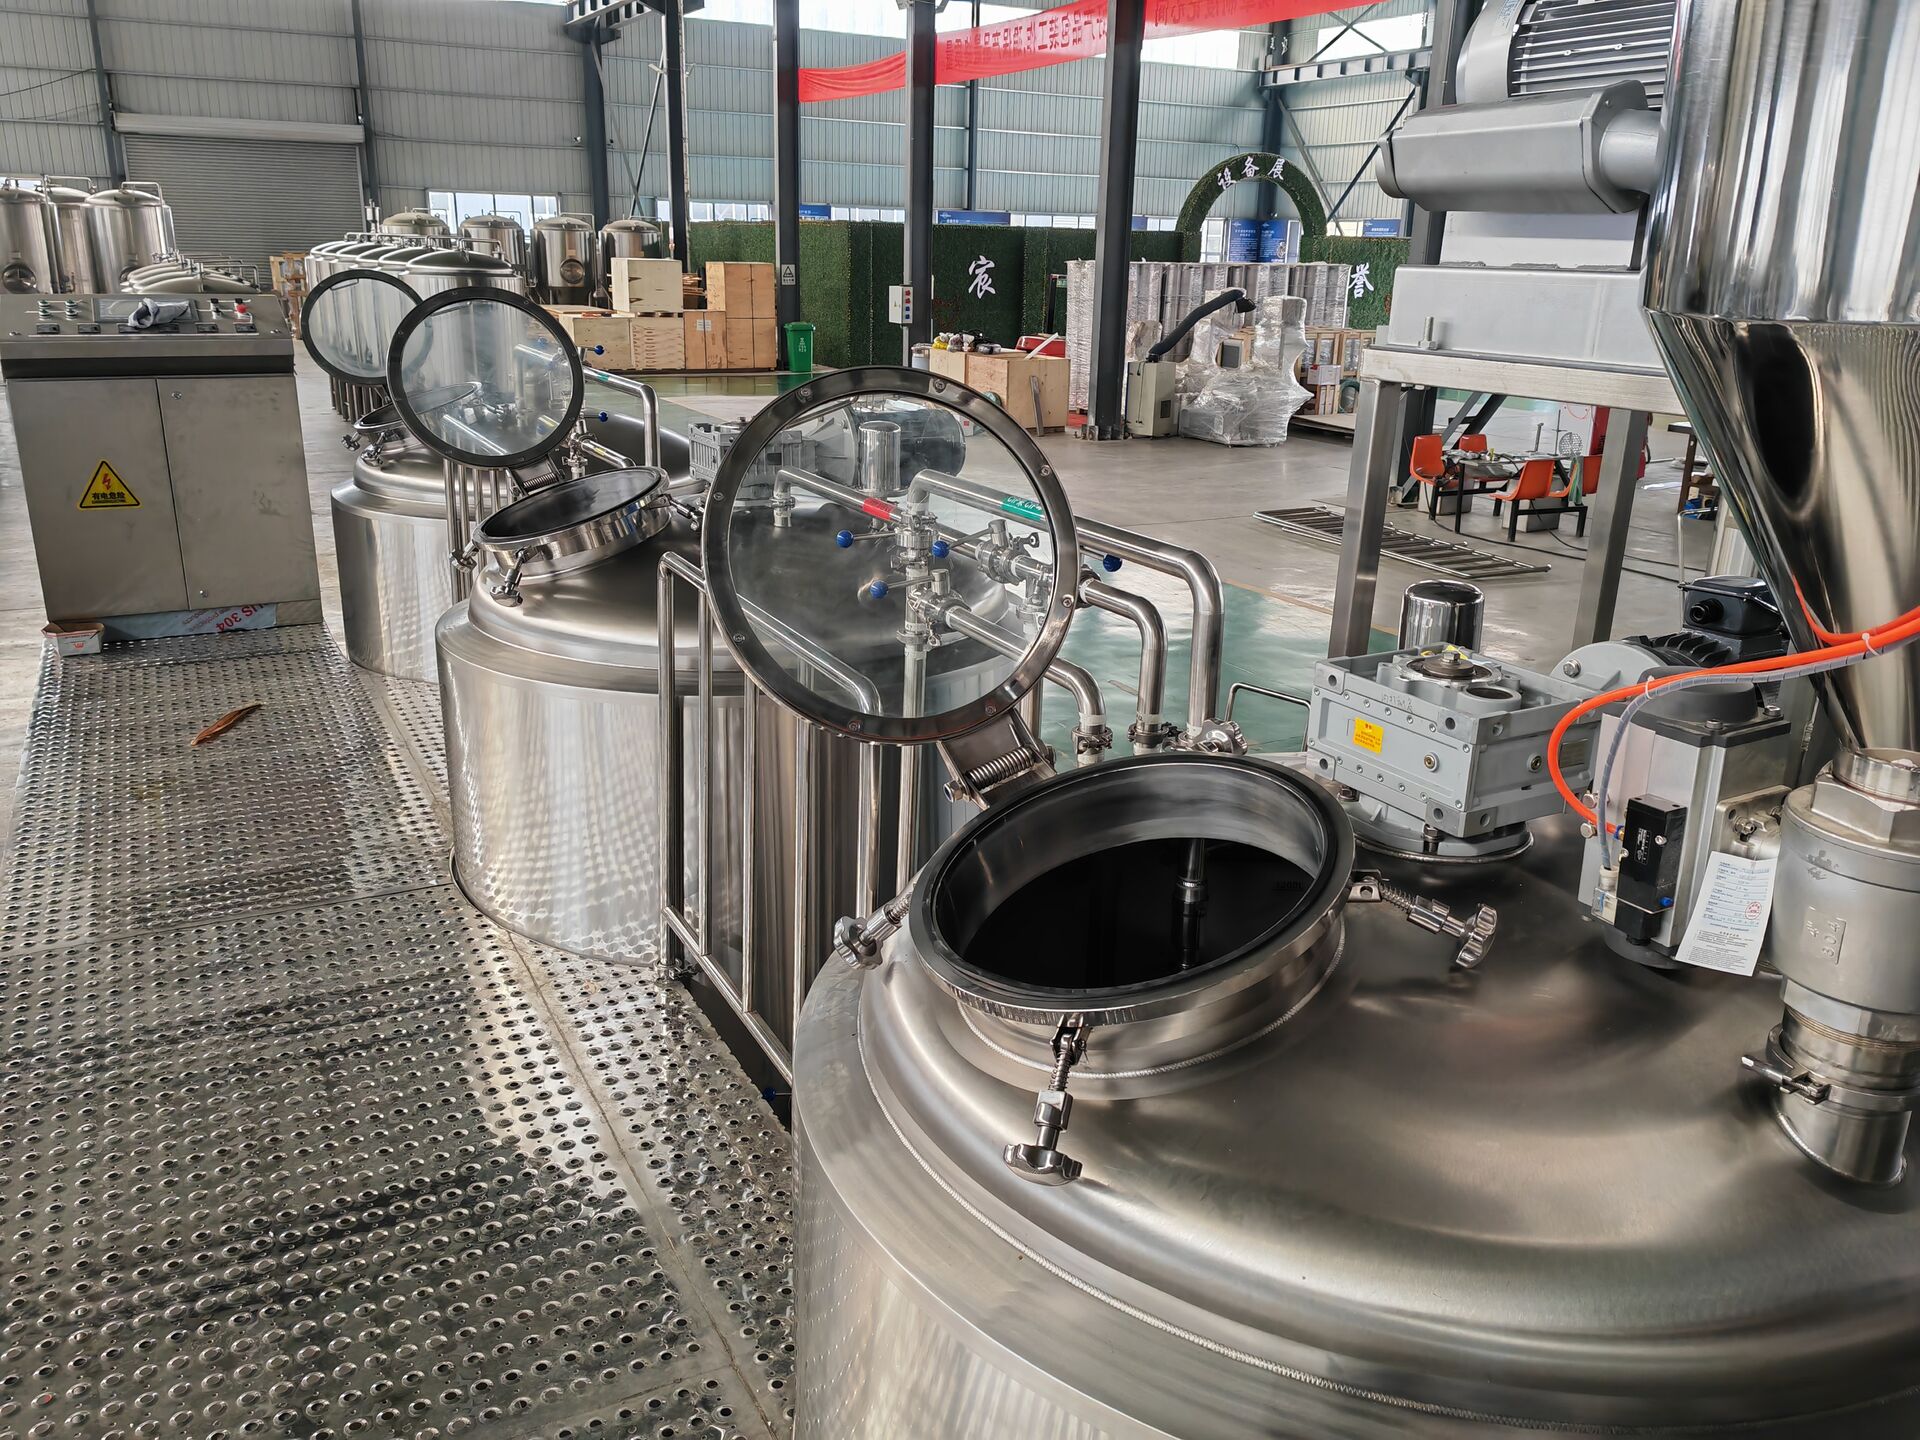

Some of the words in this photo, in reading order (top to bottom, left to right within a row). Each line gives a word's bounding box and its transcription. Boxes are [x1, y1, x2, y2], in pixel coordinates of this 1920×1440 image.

[1217, 156, 1286, 190] 设备展
[968, 255, 996, 299] 宸
[1348, 262, 1375, 299] 誉
[92, 491, 125, 500] 有电危险
[215, 612, 242, 633] 304
[1822, 920, 1841, 957] 304
